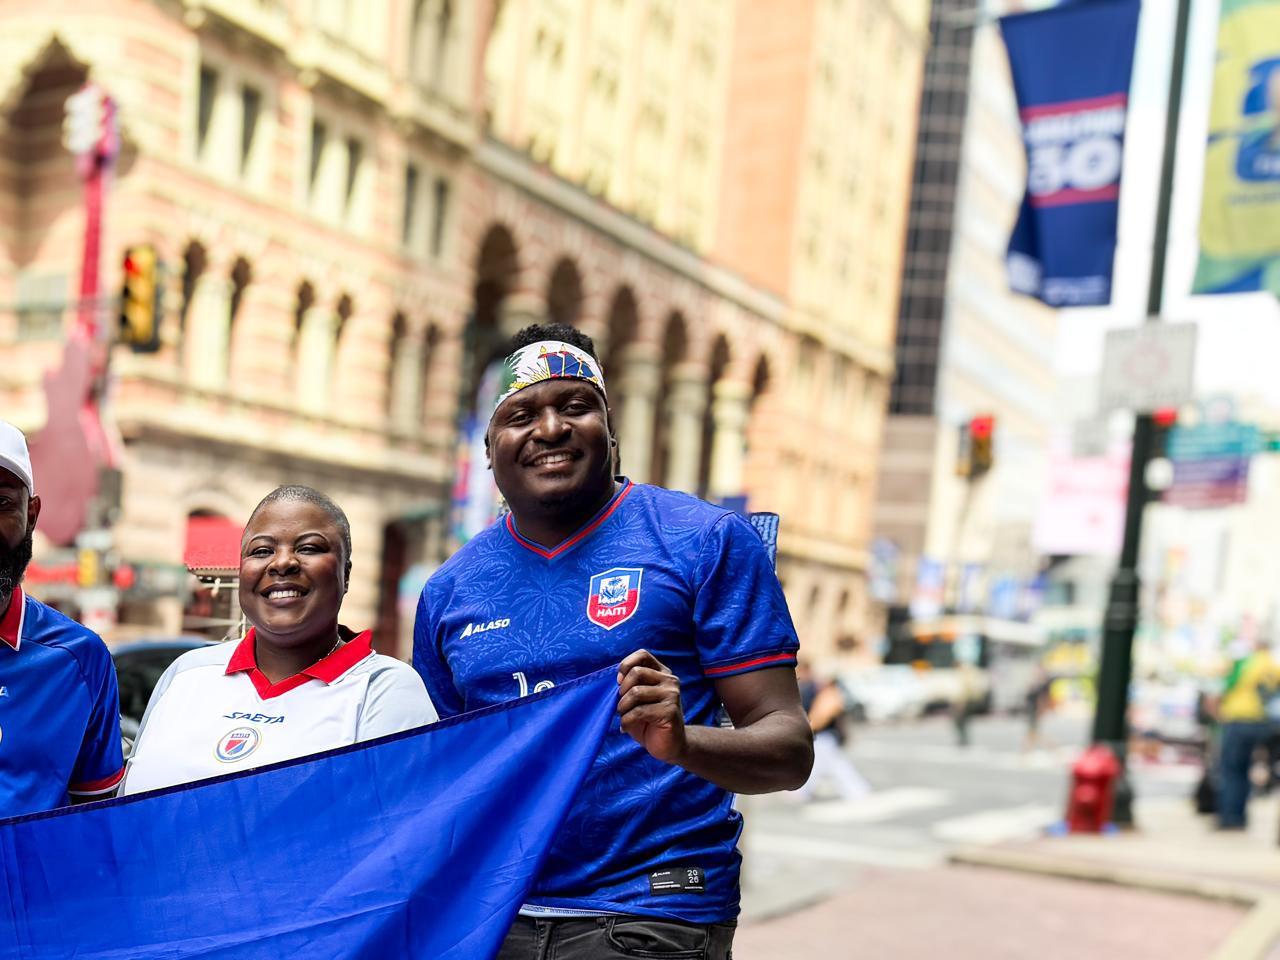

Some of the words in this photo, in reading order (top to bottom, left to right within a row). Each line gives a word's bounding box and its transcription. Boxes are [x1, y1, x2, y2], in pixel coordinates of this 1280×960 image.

[596, 606, 627, 618] HAITI
[472, 618, 510, 634] ALASO
[222, 711, 285, 724] SAETA
